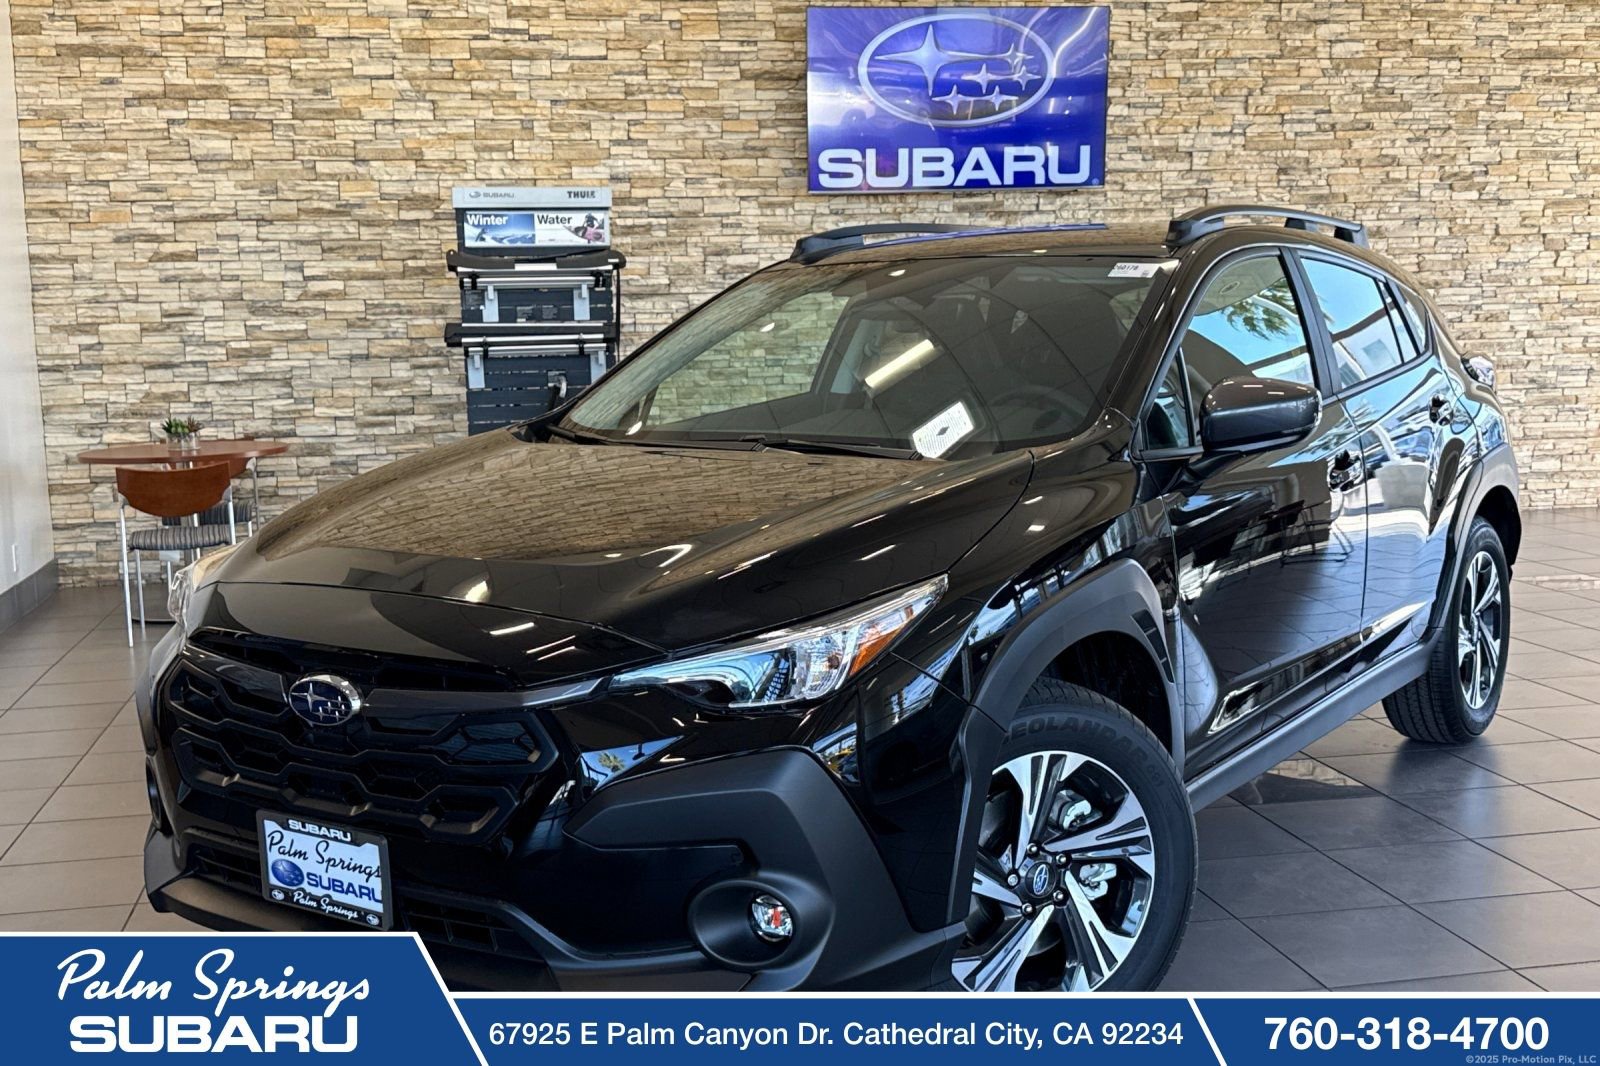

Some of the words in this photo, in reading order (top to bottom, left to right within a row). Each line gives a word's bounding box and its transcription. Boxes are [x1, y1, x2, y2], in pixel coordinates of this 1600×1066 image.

[818, 145, 1091, 188] SUBARU
[482, 191, 515, 199] SUBARU
[466, 214, 509, 226] Winter
[537, 214, 572, 225] Water
[1003, 716, 1149, 763] EOLANDAR
[287, 819, 352, 841] SUBARU
[268, 830, 308, 861] Palm
[316, 840, 381, 883] Springs
[293, 890, 318, 908] Palm
[320, 898, 359, 919] Springs
